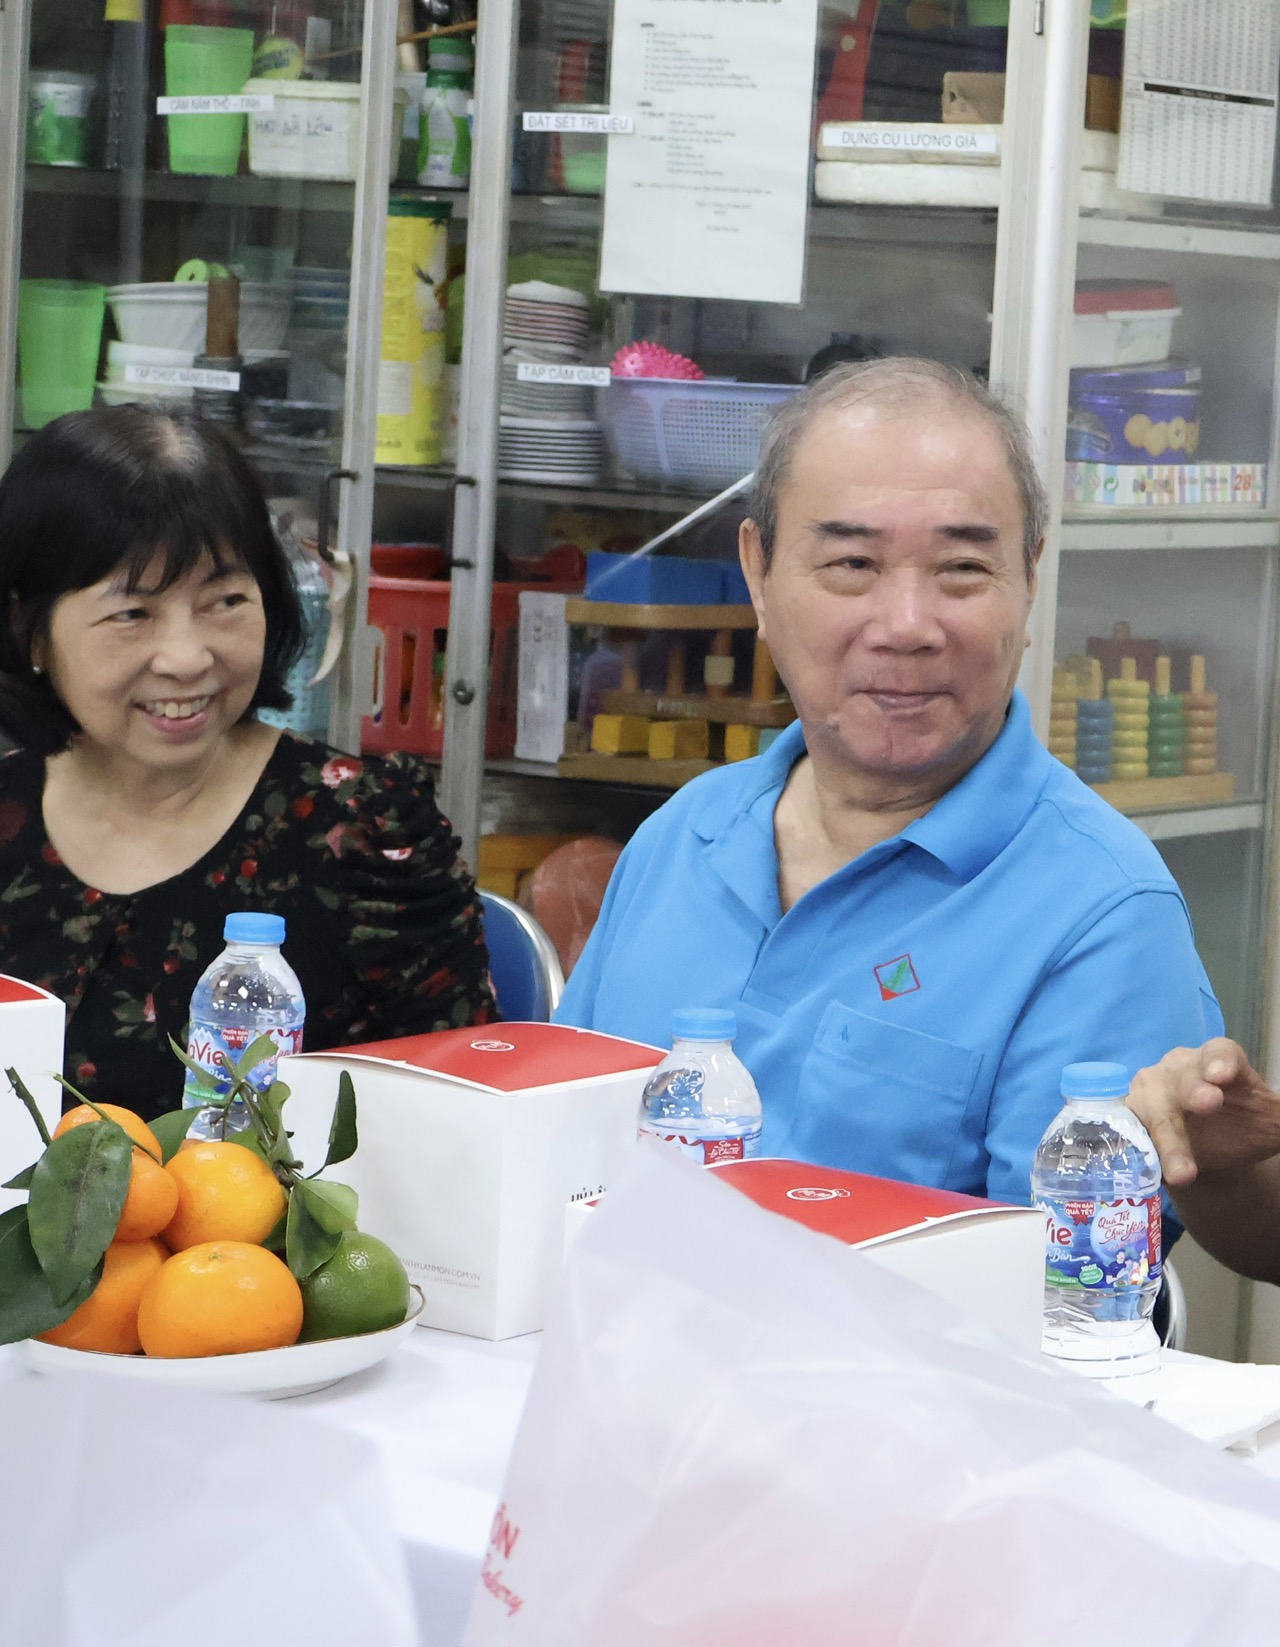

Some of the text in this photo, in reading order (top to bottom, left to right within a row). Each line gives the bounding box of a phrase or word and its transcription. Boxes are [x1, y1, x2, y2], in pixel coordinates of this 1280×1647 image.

[841, 131, 977, 148] DỤNG CỤ LƯỢNG GIÁ
[188, 1038, 225, 1066] aVie
[1080, 1208, 1094, 1216] TẾT
